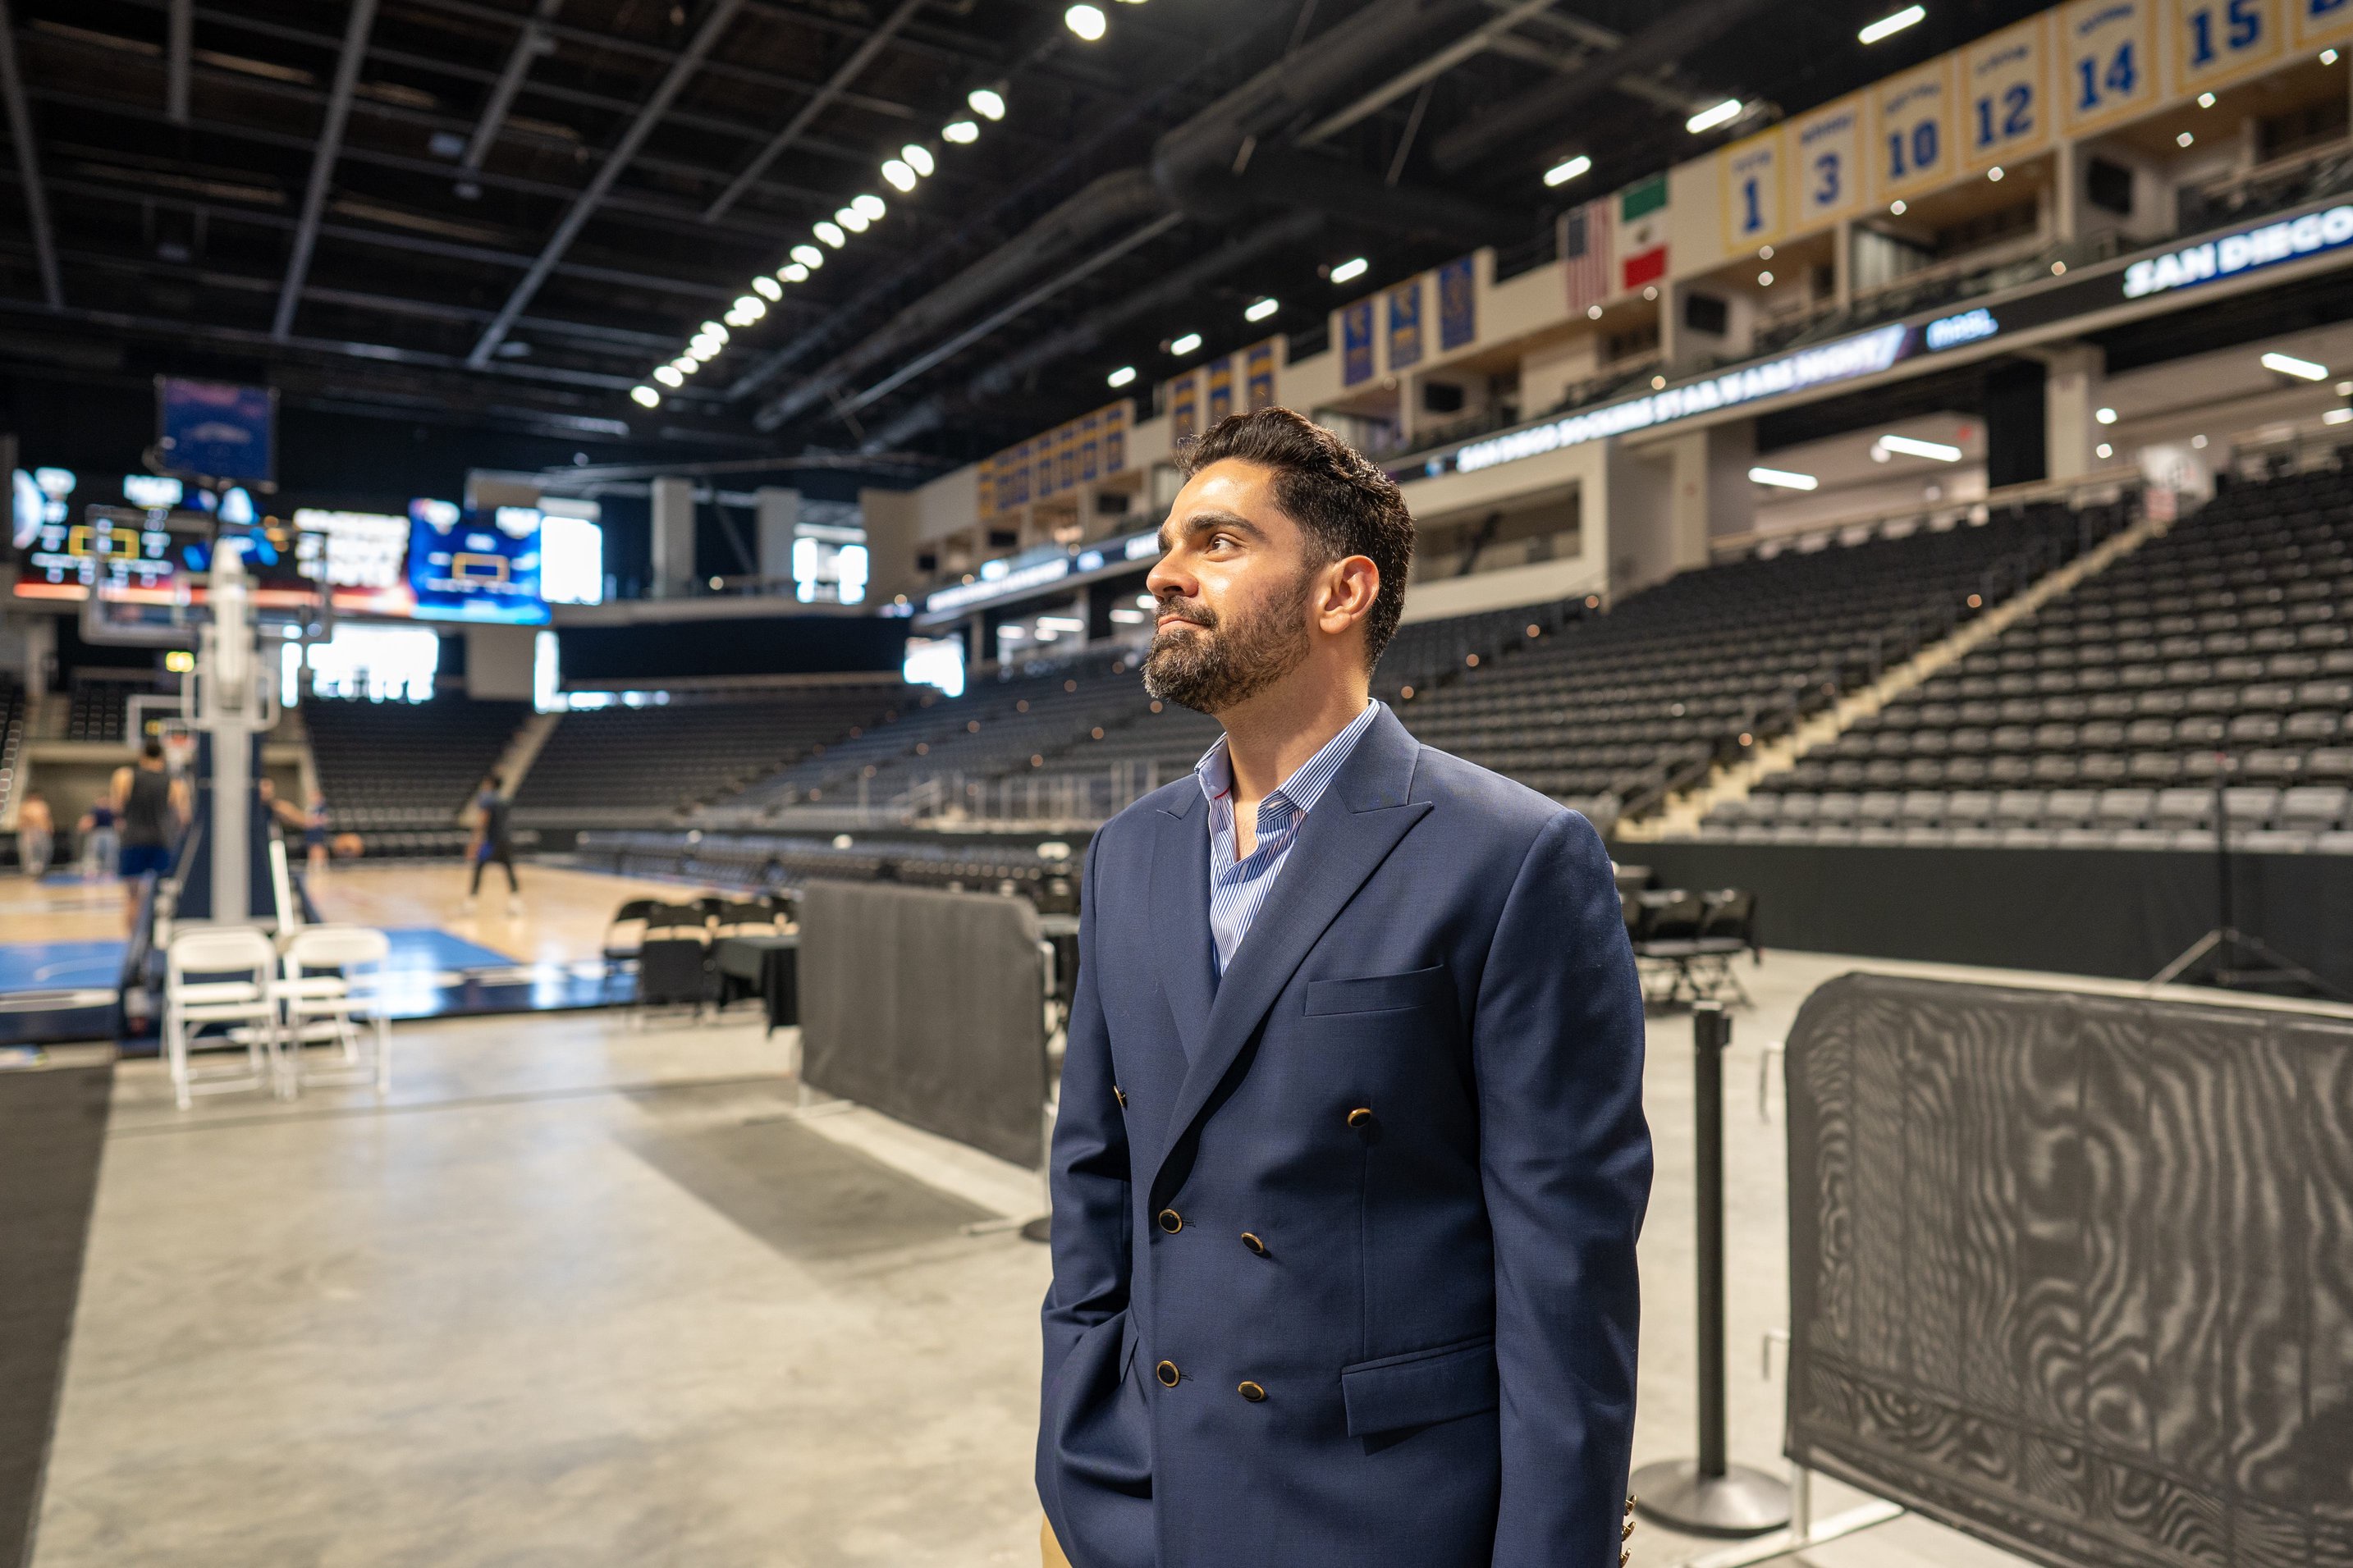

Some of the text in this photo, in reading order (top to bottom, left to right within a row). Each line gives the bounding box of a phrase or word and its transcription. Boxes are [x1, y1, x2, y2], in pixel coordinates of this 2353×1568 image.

[2189, 0, 2262, 67] 15
[2077, 40, 2137, 112] 14
[1975, 83, 2033, 149] 12
[1815, 152, 1840, 206] 3
[1889, 119, 1938, 180] 10
[1742, 177, 1762, 232] 1
[2122, 205, 2353, 299] SAN DIEGO
[1456, 438, 1500, 473] SAN
[1500, 423, 1559, 463] DIEGO
